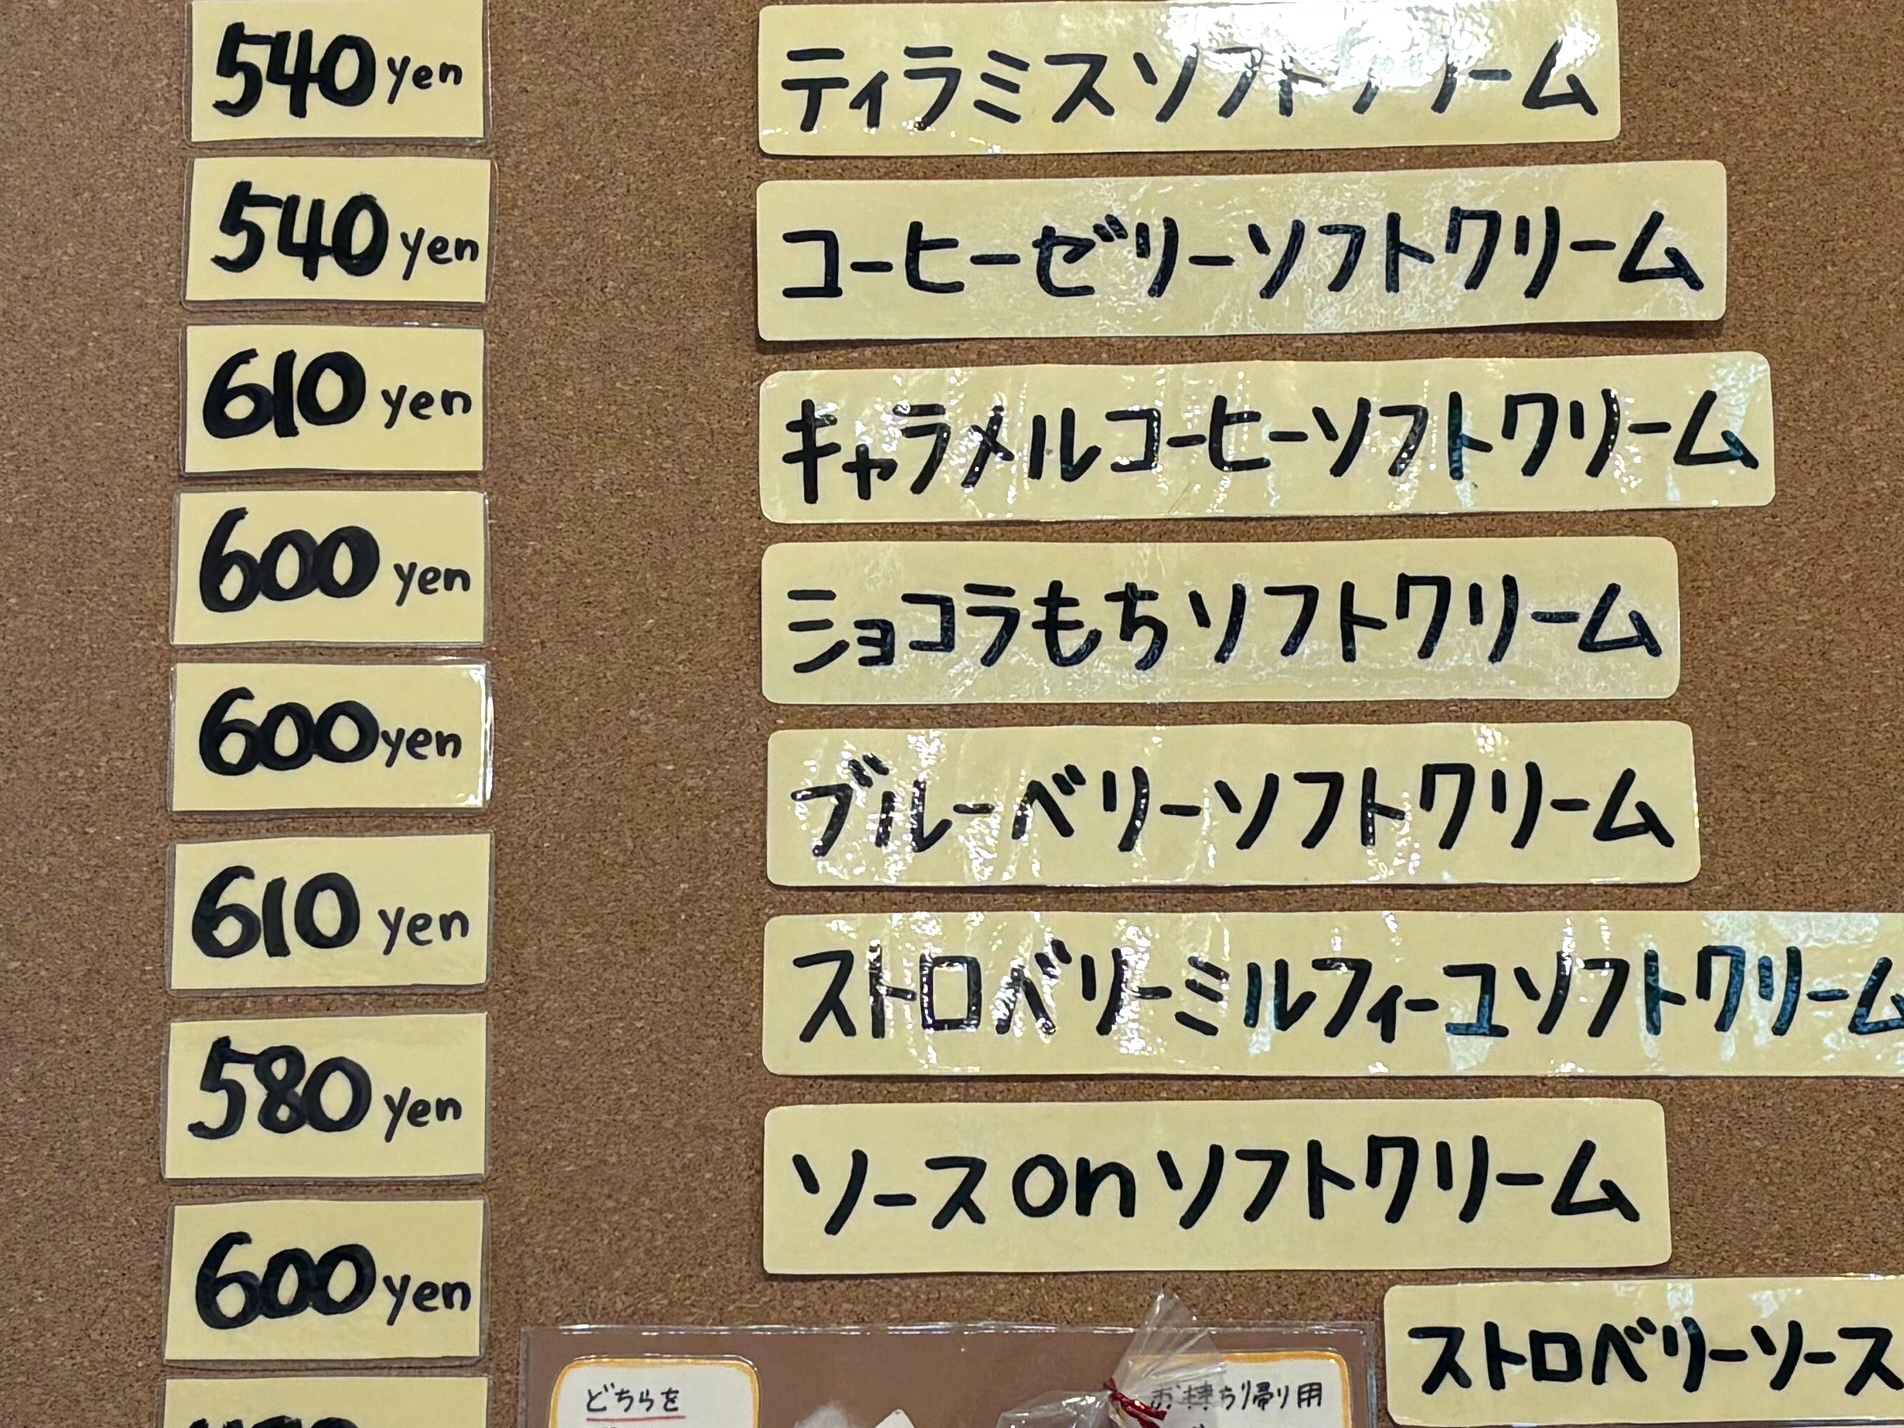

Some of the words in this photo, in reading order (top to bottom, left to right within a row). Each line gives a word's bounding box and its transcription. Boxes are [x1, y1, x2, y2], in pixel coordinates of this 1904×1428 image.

[782, 205, 1705, 300] コーヒーゼリーソフトクリーム
[781, 388, 1760, 505] キャラメルコーヒーソフトクリーム
[787, 572, 1663, 674] ショコラもちソフトクリーム
[792, 754, 1675, 858] ブルーベリーソフトクリーム
[792, 1134, 1640, 1236] ソースonソフトクリーム
[586, 1382, 680, 1413] どちらを
[1407, 1316, 1904, 1397] ストロベリーソース
